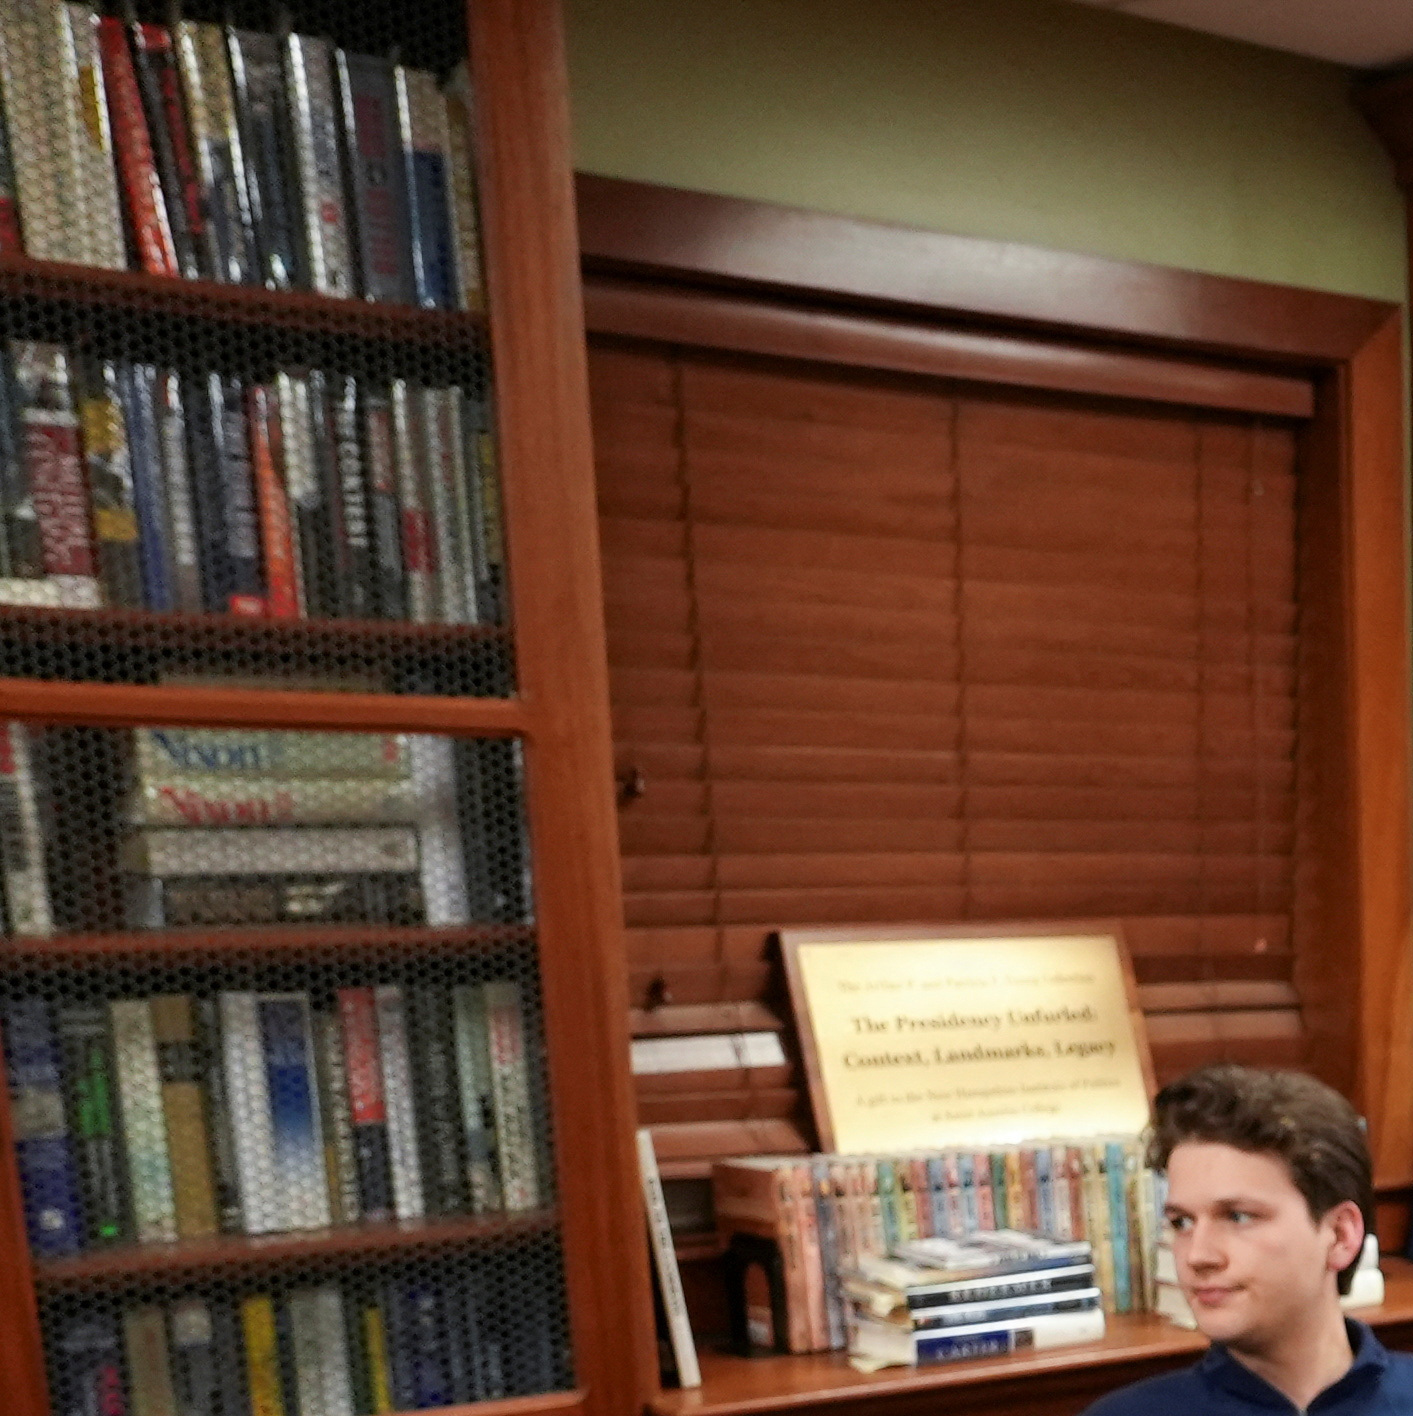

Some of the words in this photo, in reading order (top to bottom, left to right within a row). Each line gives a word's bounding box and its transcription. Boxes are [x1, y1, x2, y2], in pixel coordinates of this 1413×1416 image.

[852, 1013, 888, 1034] The
[896, 1010, 1002, 1034] Presidency
[843, 1050, 930, 1073] Context,
[933, 1042, 1048, 1067] Landmarks,
[1053, 1036, 1117, 1061] Legacy
